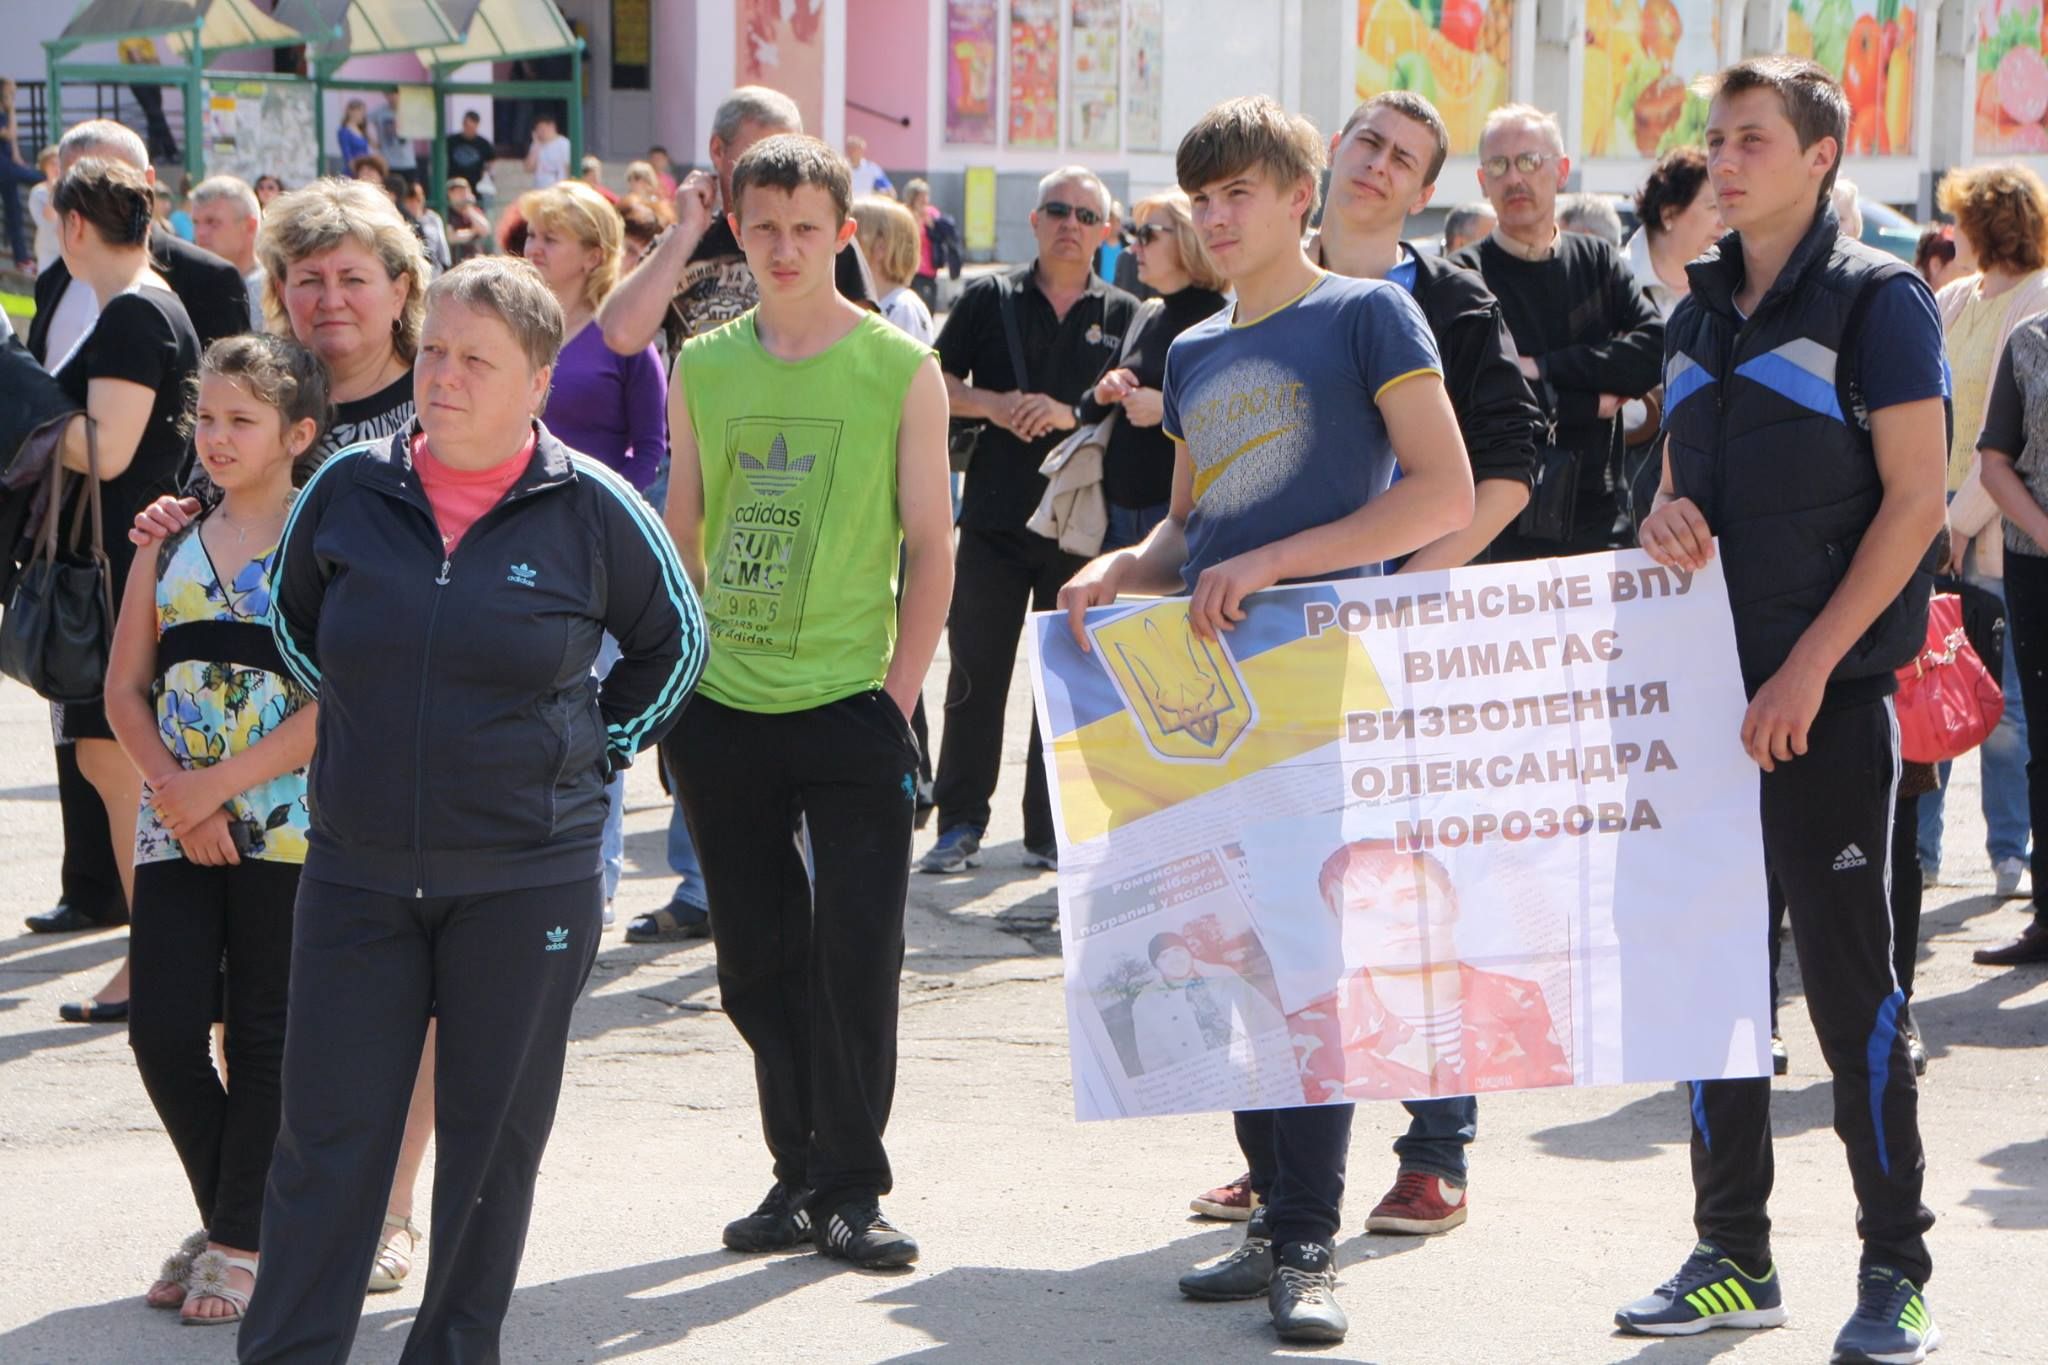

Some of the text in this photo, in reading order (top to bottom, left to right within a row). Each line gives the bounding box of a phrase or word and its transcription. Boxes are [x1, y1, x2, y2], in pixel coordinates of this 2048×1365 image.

[731, 532, 794, 562] RUN
[1304, 565, 1696, 636] РОМЕНСЬКЕ ВПУ
[1403, 629, 1624, 684] ВИМАГАЄ
[1346, 681, 1671, 745] ВИЗВОЛЕННЯ
[1351, 739, 1678, 799] ОЛЕКСАНДРА
[1394, 798, 1662, 854] МОРОЗОВА
[1832, 856, 1868, 871] adidas
[1080, 902, 1158, 938] потрапив
[1170, 877, 1226, 904] полон
